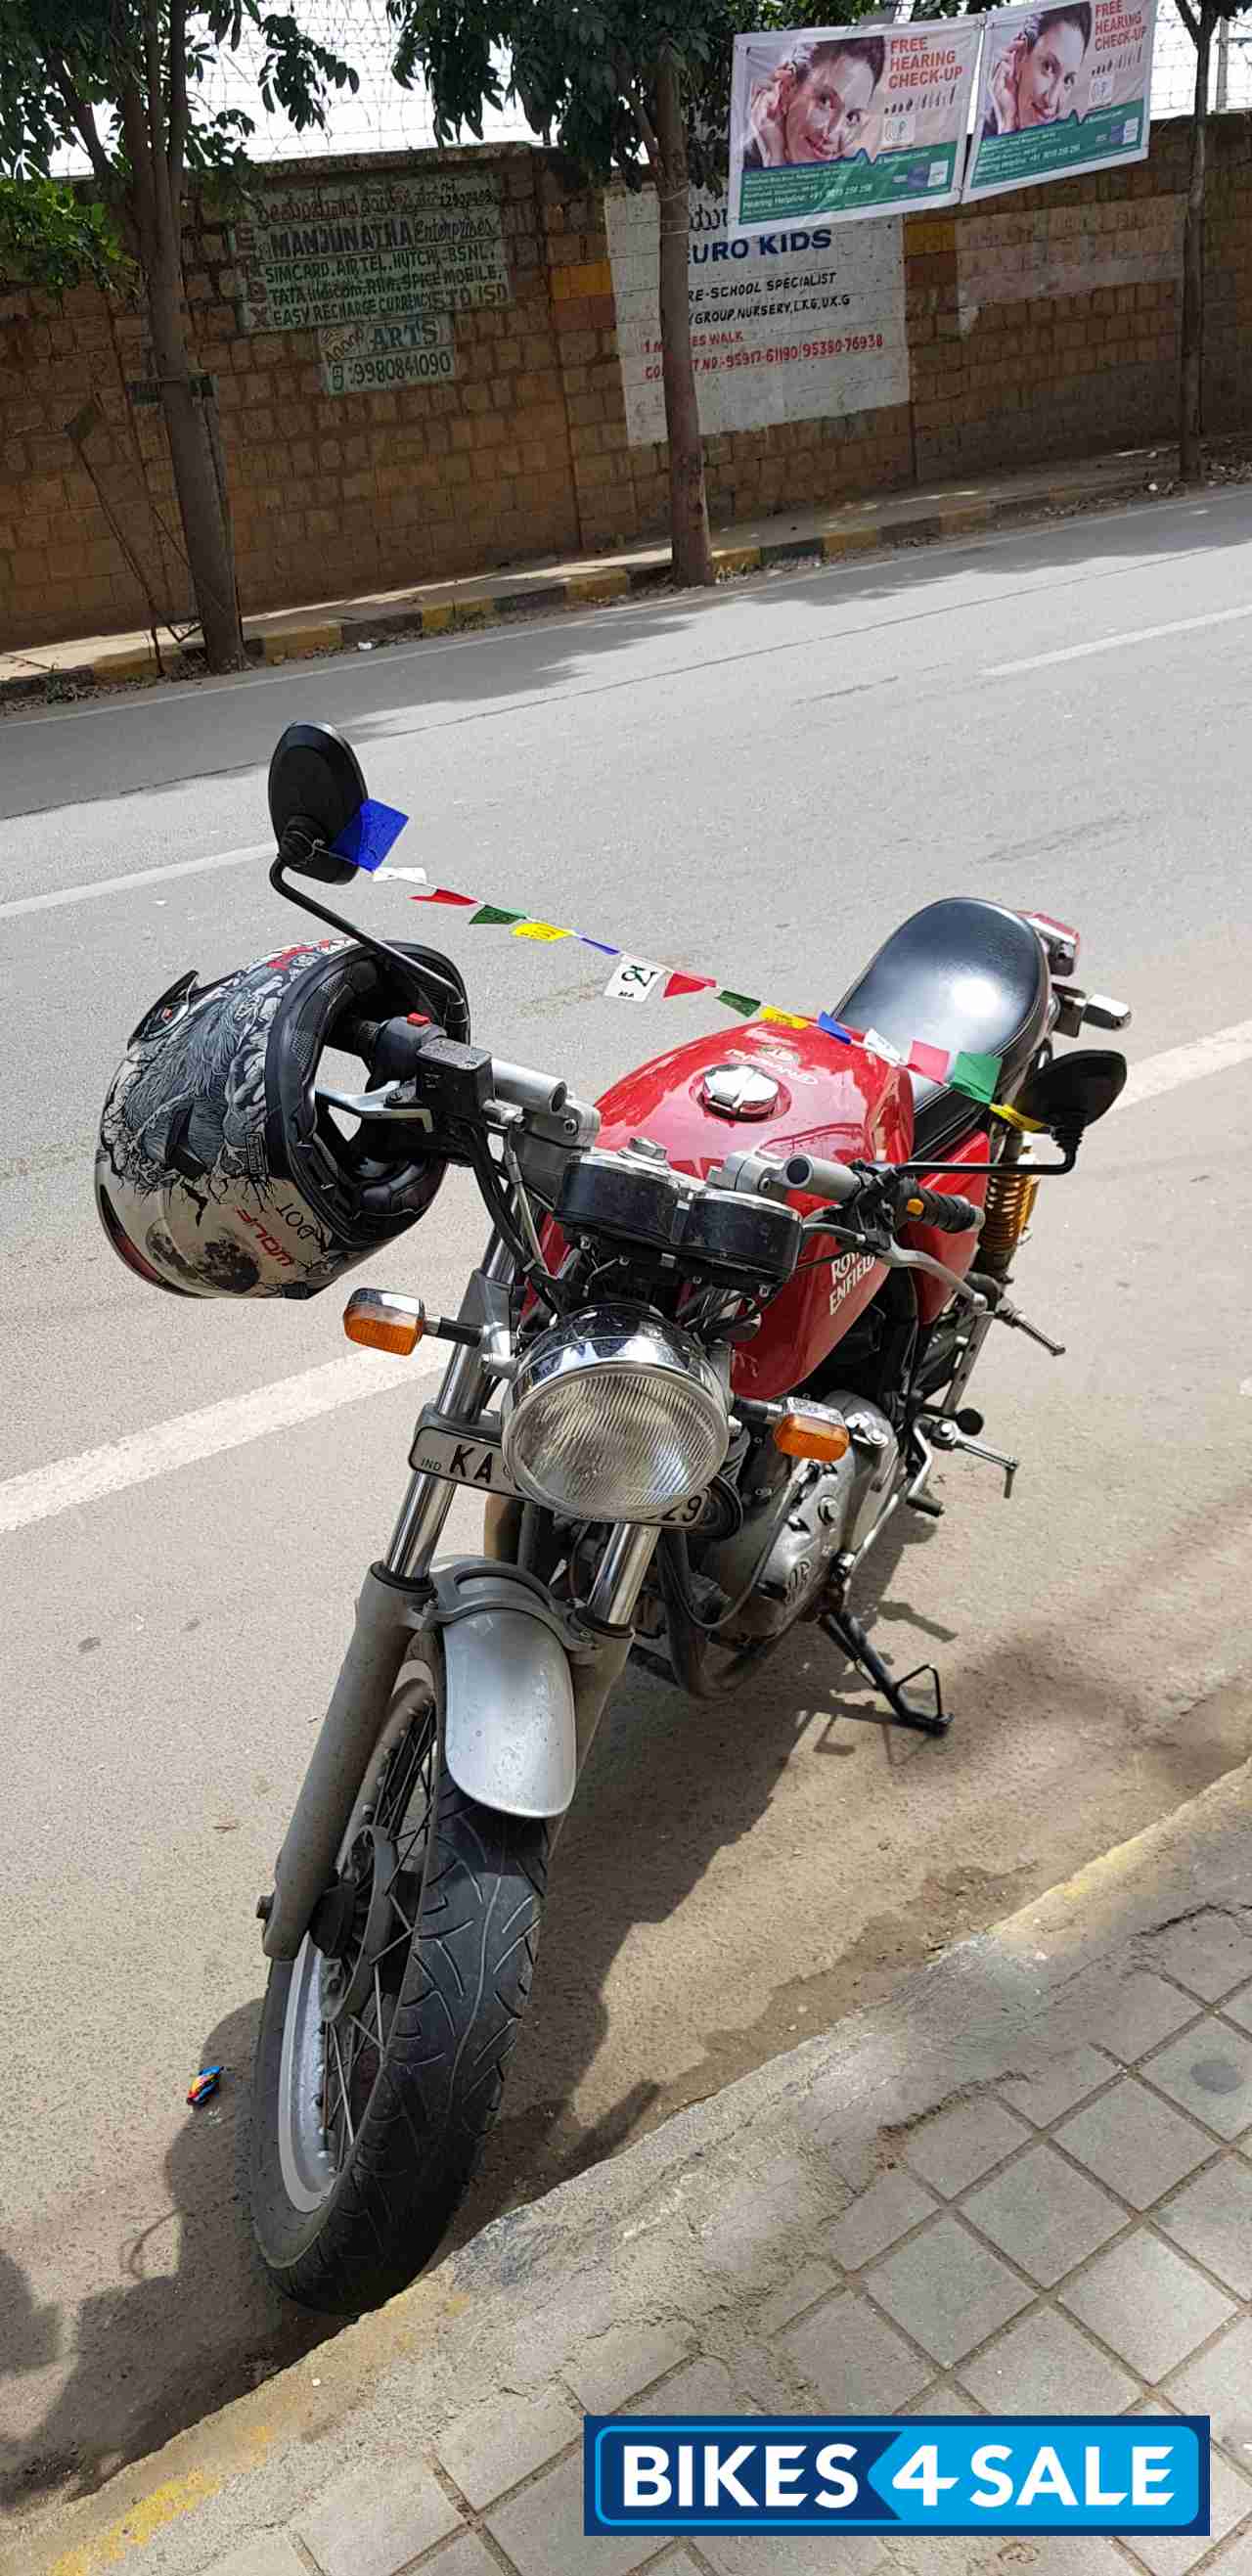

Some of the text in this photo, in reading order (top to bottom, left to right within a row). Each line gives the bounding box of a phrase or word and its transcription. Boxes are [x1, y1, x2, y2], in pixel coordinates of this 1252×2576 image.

[1096, 0, 1123, 18] FREE
[1096, 15, 1142, 35] HEARING
[1096, 26, 1147, 51] CHECK-UP
[891, 36, 928, 54] FREE
[891, 50, 956, 71] HEARING
[889, 66, 963, 89] CHECK-UP
[689, 228, 831, 265] URO KIDS
[689, 272, 837, 303] RE-SCHOOL SPECIALIST
[235, 1204, 295, 1267] WOLF
[276, 1202, 315, 1241] DOT
[829, 1255, 877, 1316] ENFIELD
[421, 1456, 442, 1471] IND
[449, 1443, 494, 1484] KA
